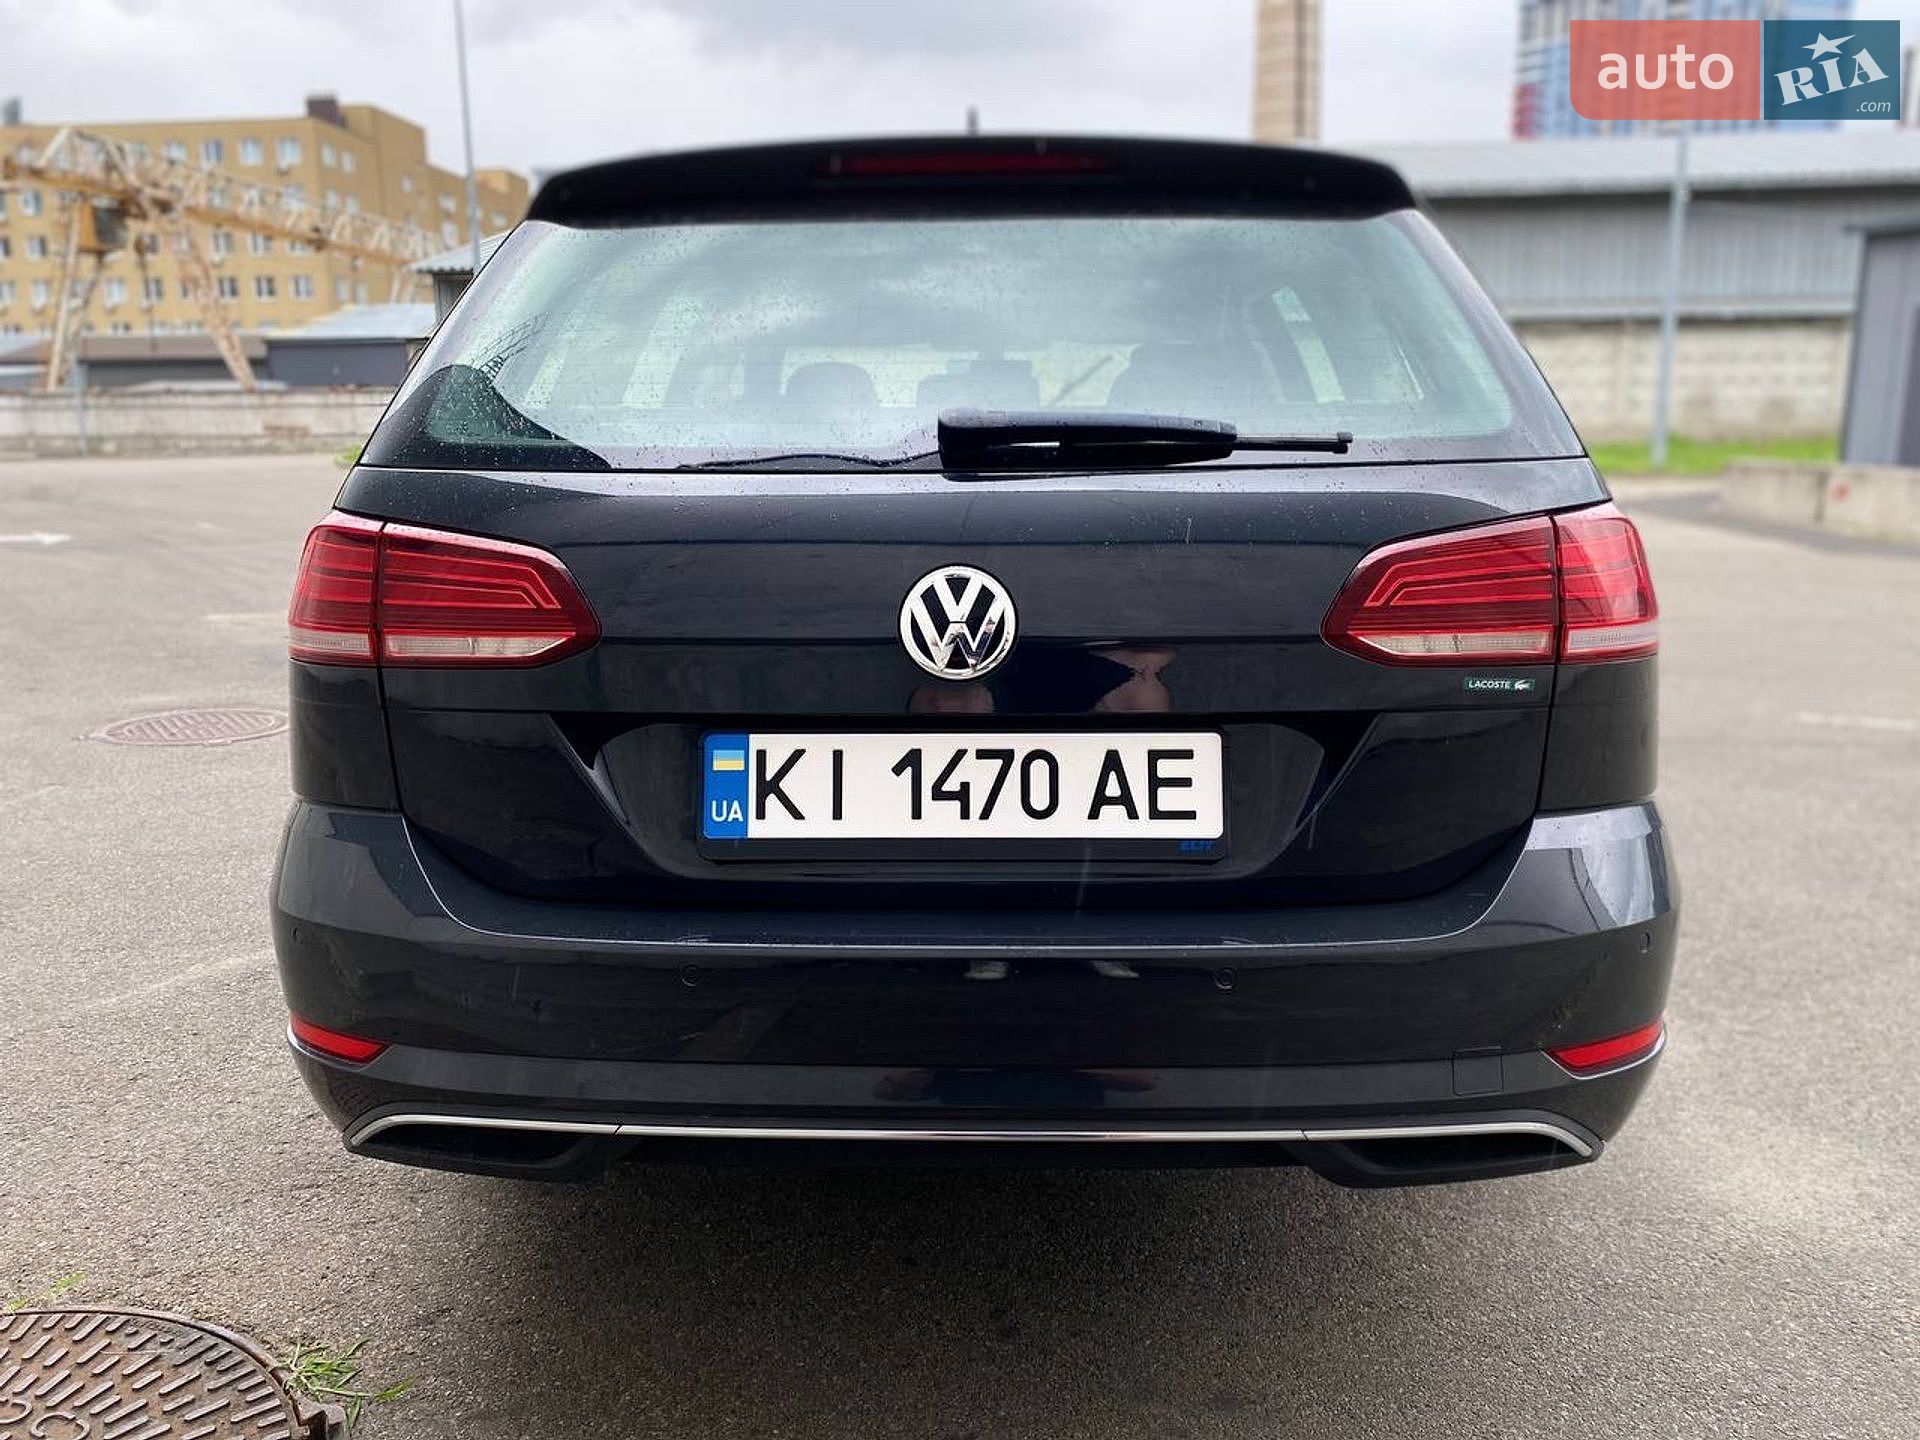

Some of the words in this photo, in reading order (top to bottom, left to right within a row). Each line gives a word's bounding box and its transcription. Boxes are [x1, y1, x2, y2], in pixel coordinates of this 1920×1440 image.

[1468, 680, 1512, 690] LACOSTE
[755, 748, 844, 821] KI
[891, 748, 1060, 821] 1470
[1087, 748, 1197, 821] AE
[711, 799, 744, 823] UA
